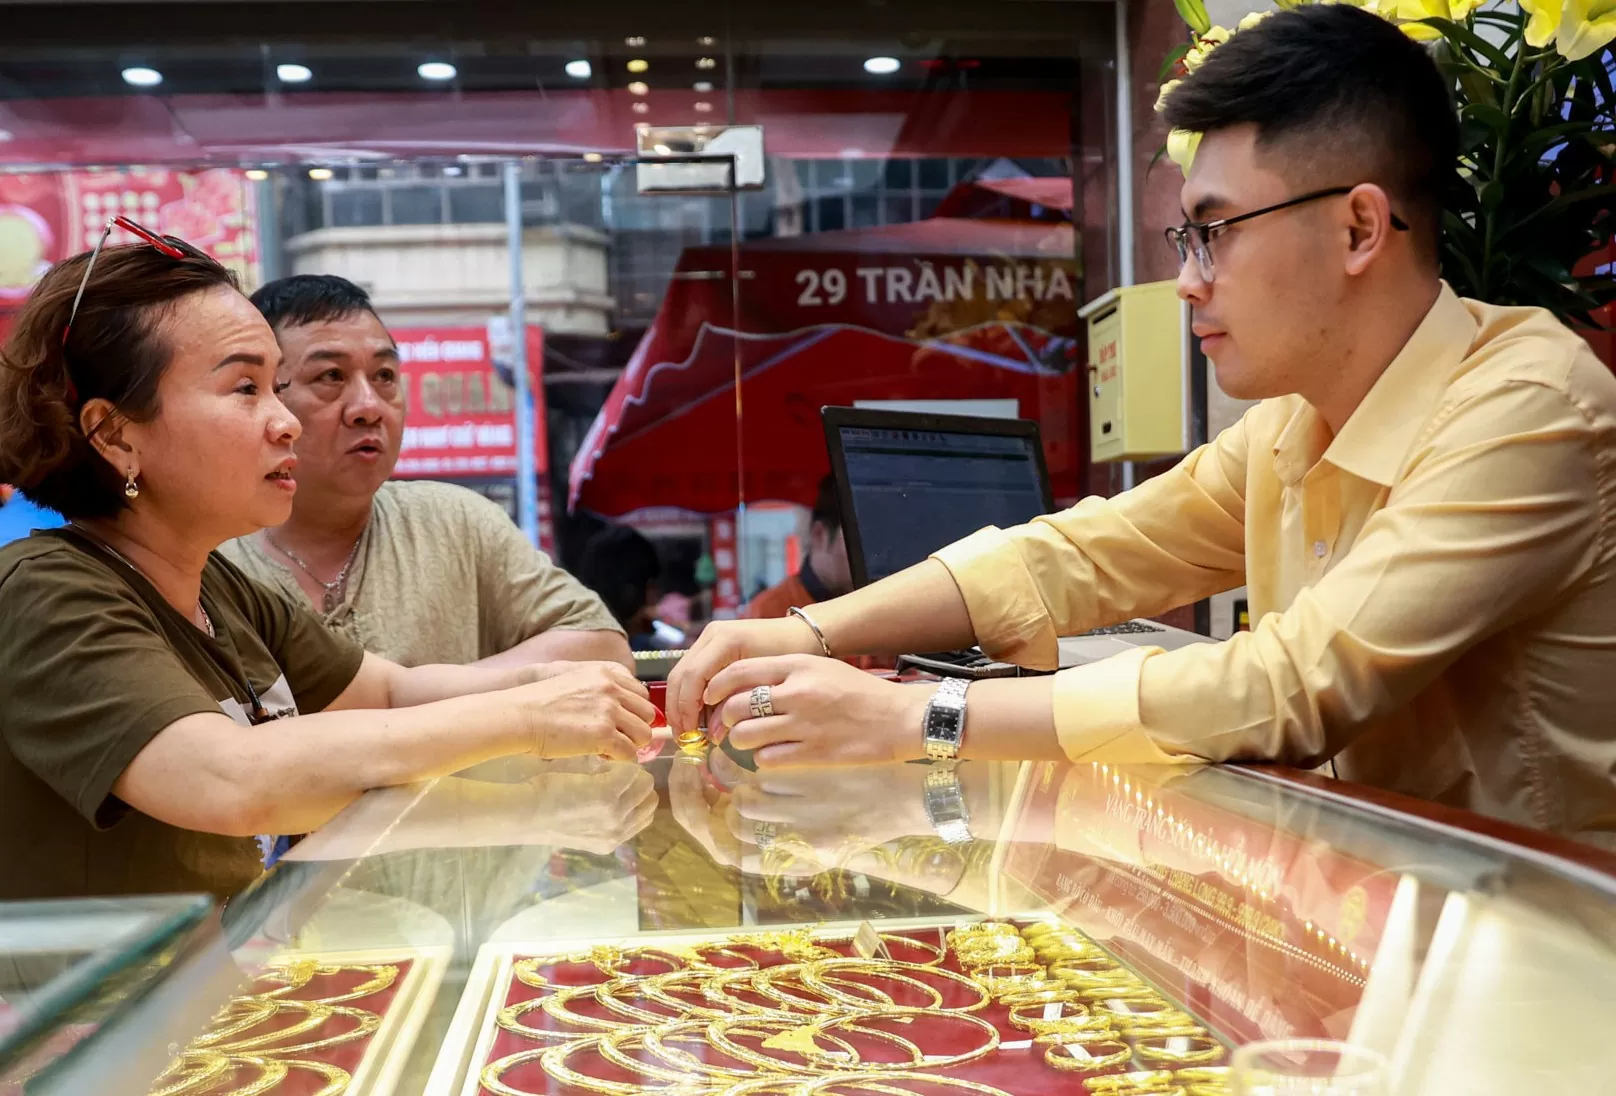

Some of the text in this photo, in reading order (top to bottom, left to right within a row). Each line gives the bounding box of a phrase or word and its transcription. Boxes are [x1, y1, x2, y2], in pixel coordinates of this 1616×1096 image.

[796, 269, 846, 306] 29
[856, 258, 975, 302] TRẦN
[1105, 792, 1133, 823] VÀNG
[1131, 807, 1168, 840] TRANG
